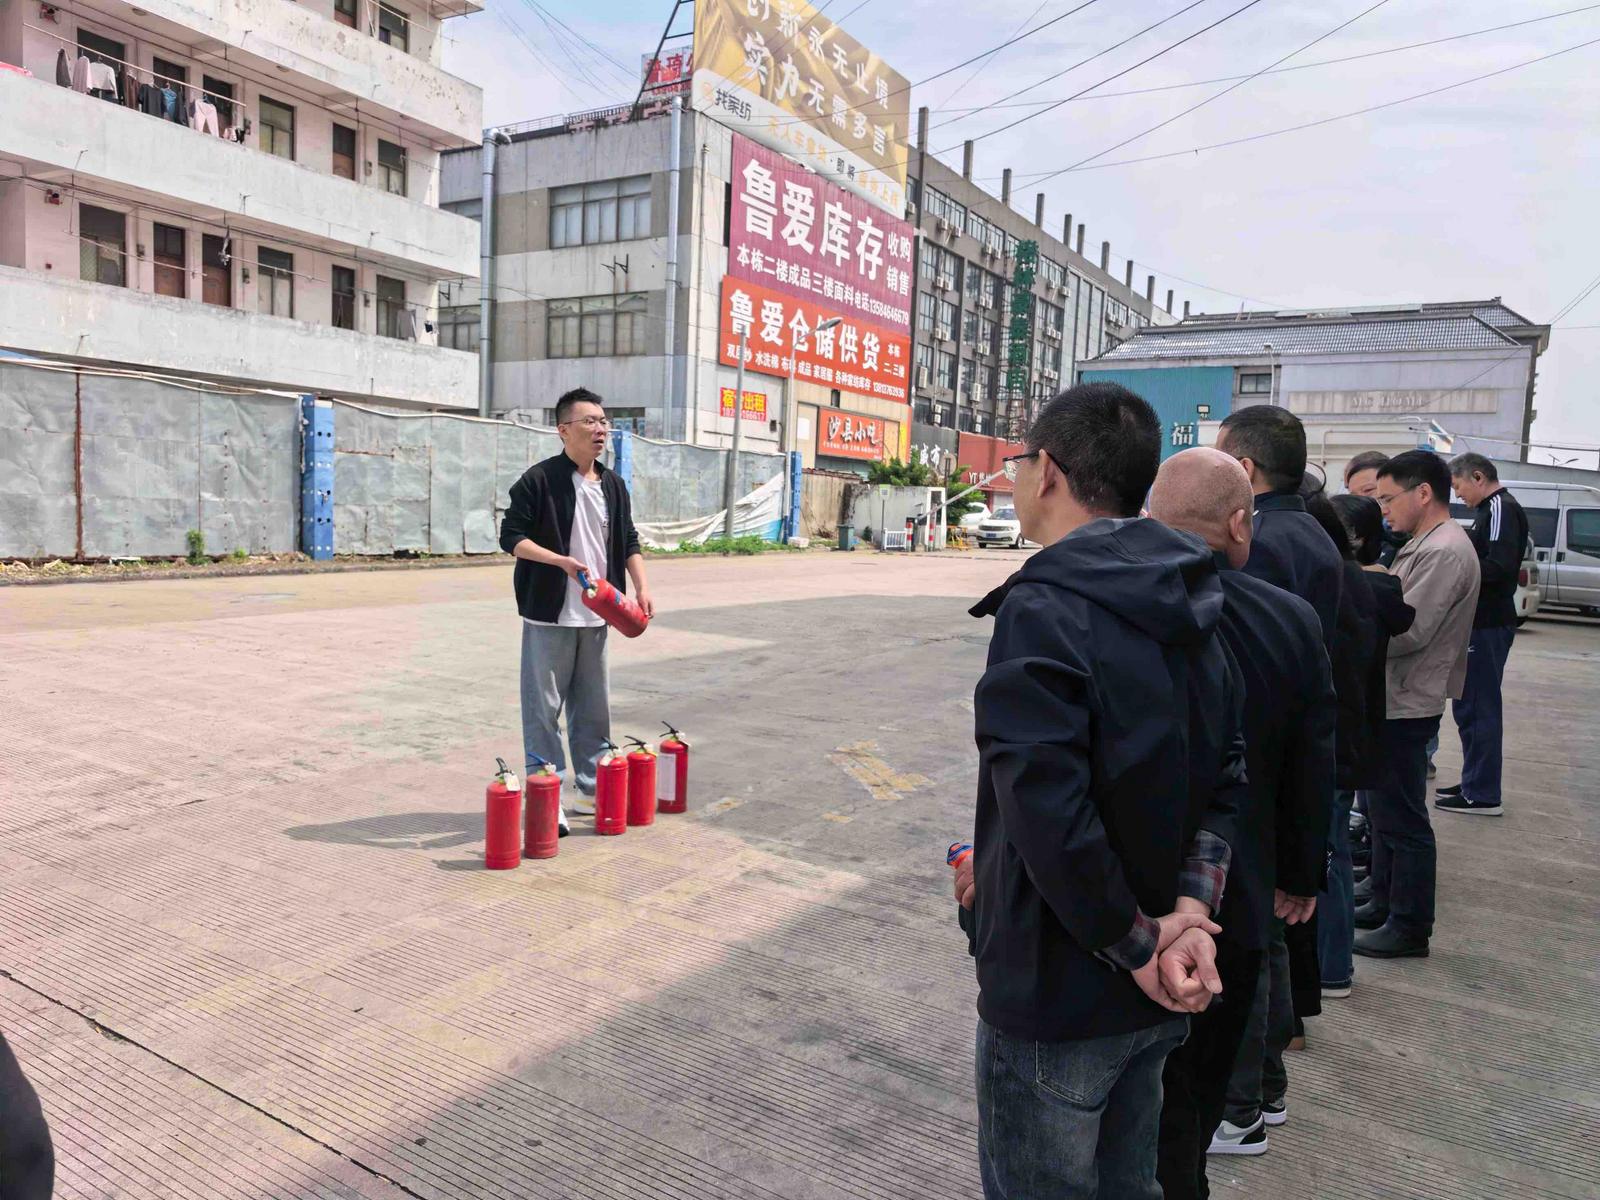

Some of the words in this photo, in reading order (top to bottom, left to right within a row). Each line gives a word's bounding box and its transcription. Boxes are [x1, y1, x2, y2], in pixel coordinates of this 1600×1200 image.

[744, 31, 886, 156] 实力无需多言
[739, 158, 884, 281] 鲁爱库存
[887, 231, 911, 262] 收购
[737, 243, 854, 306] 本栋二楼成品三楼面料
[886, 266, 910, 296] 销售
[729, 288, 881, 372] 鲁爱仓储供货
[722, 389, 764, 413] 宿出租
[828, 416, 881, 446] 沙县小吃
